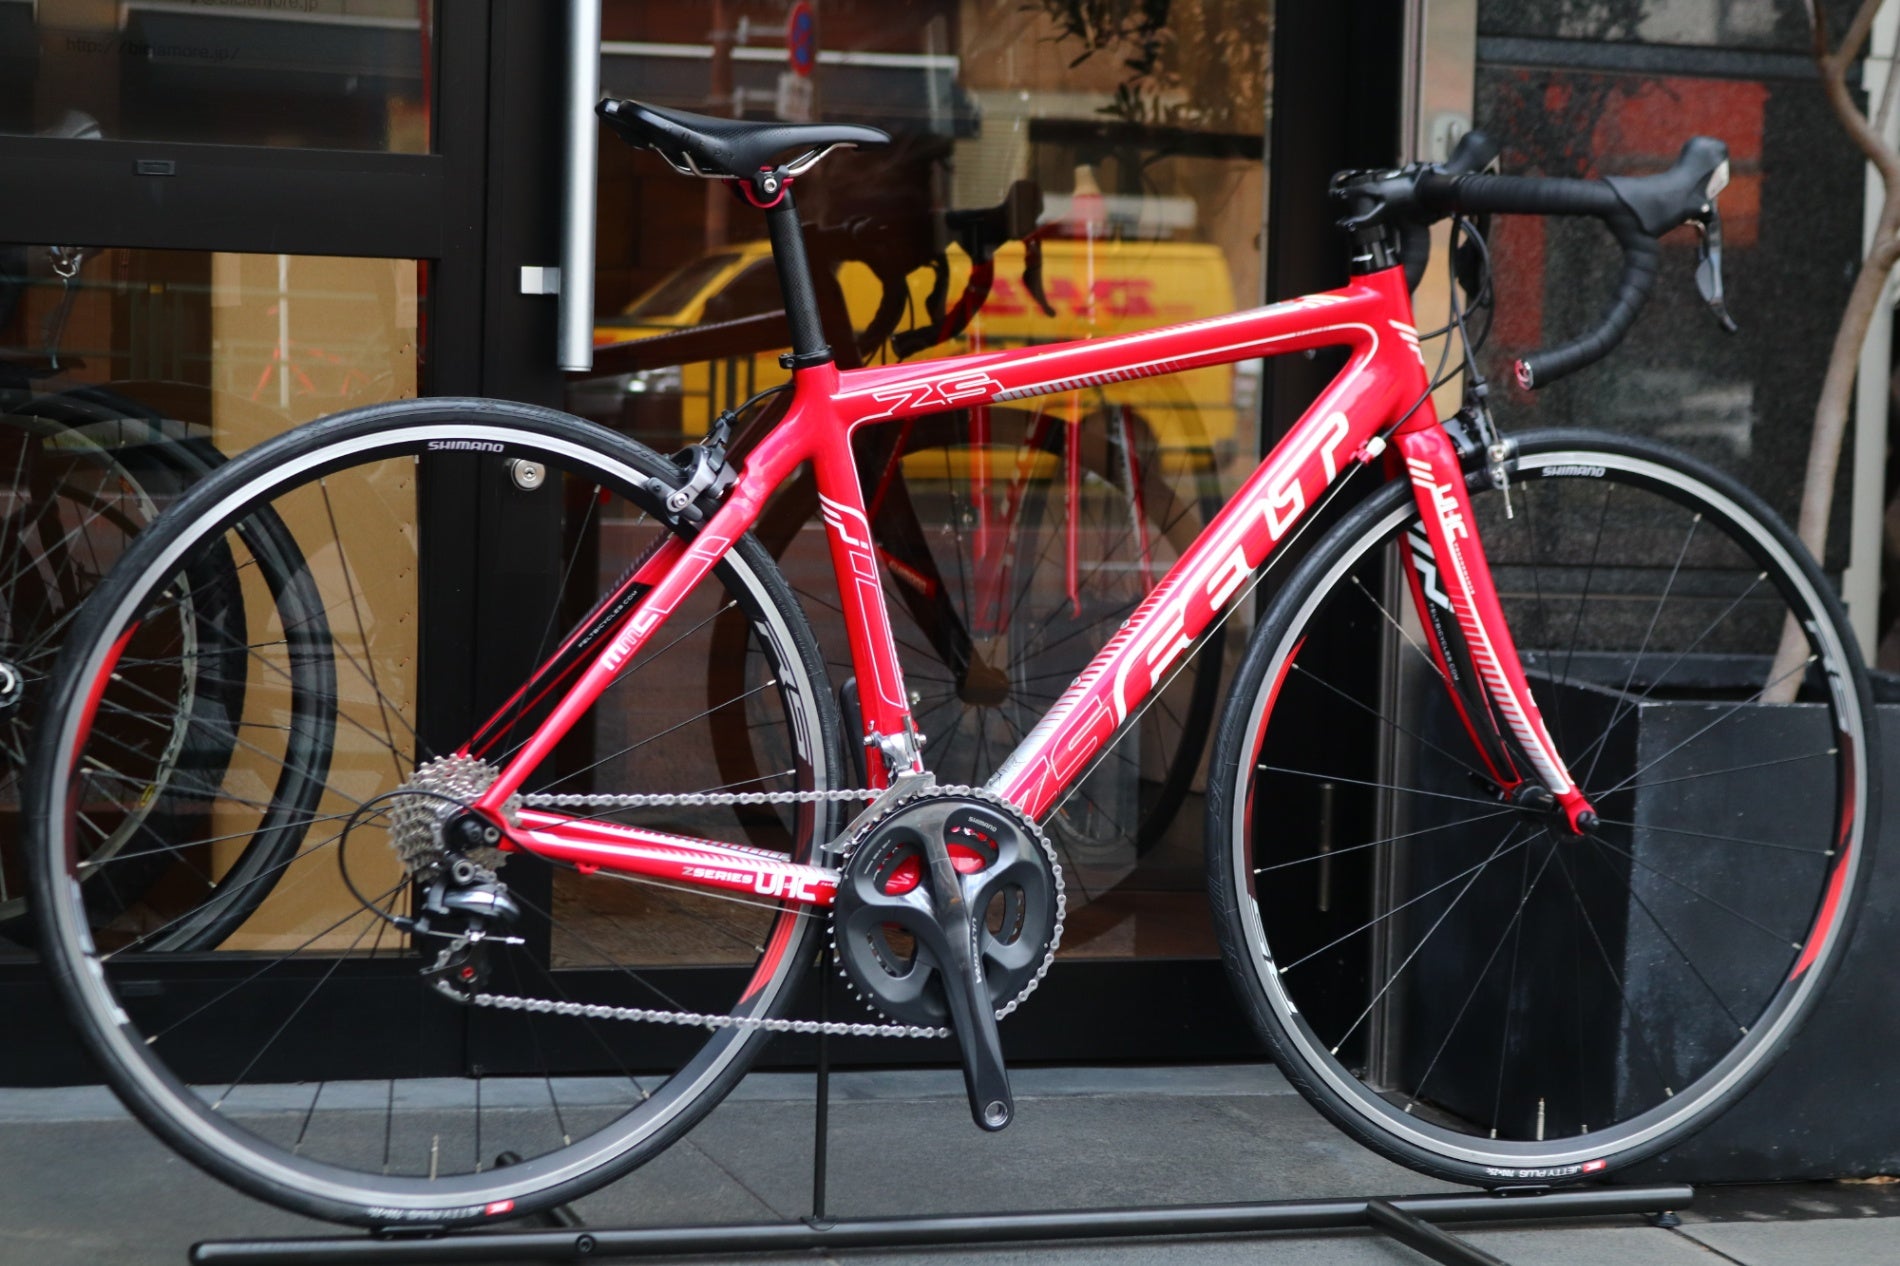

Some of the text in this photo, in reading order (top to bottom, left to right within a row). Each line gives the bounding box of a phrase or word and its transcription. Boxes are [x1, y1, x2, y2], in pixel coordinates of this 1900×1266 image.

[428, 441, 504, 452] SHIMANO
[1541, 466, 1606, 478] SHIMANO
[968, 816, 997, 832] SHIMANO
[1520, 1168, 1546, 1178] PLUS
[1548, 1165, 1582, 1177] JETTY
